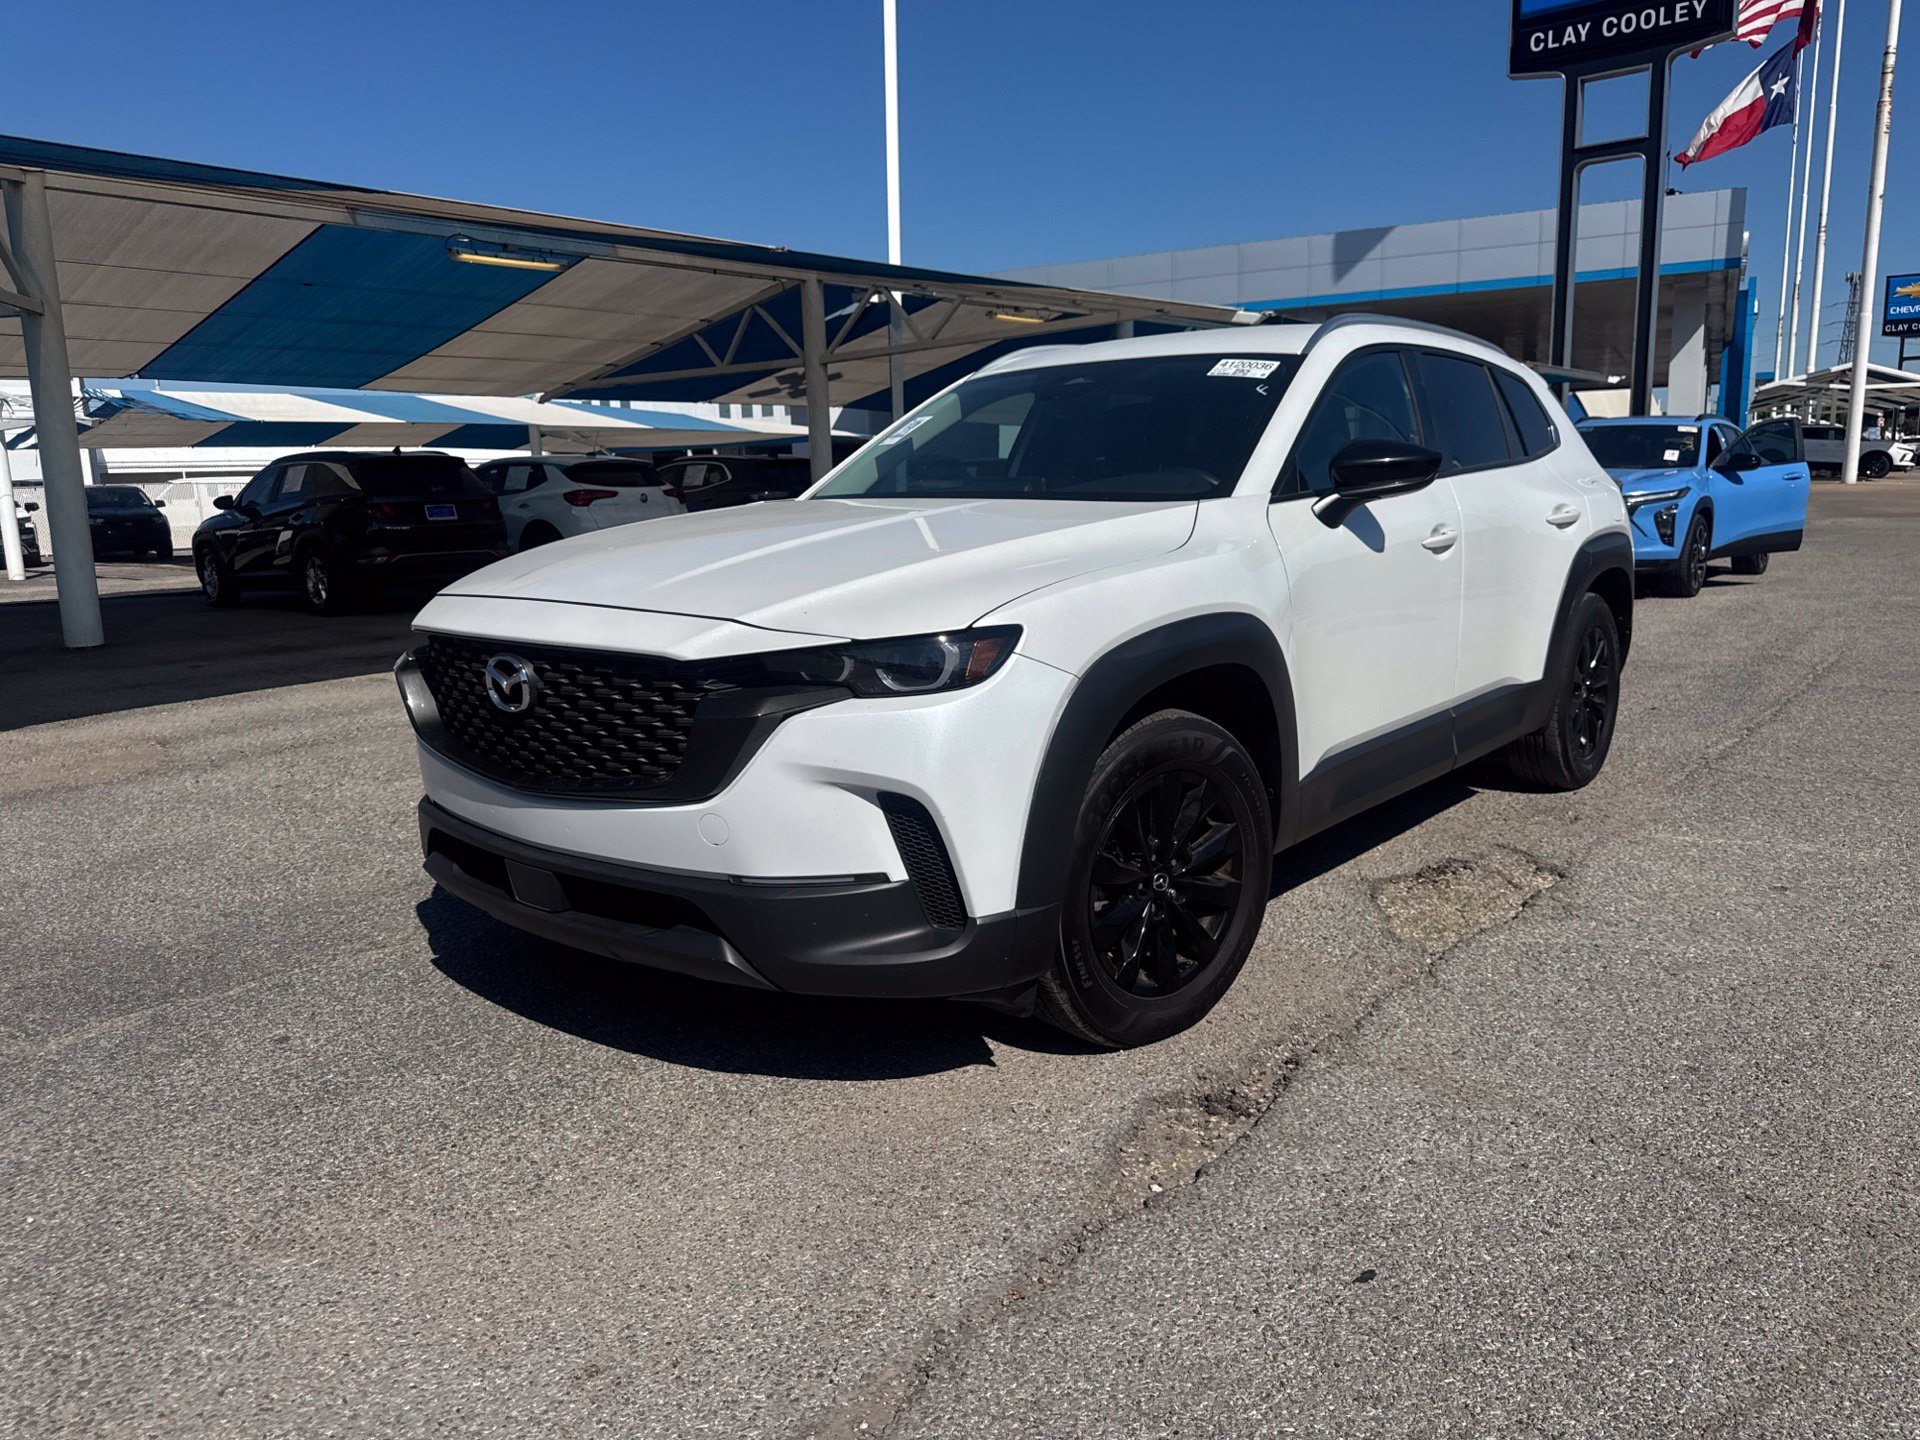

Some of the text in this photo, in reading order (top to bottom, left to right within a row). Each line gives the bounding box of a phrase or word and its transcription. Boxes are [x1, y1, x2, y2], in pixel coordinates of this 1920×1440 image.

[1530, 0, 1706, 52] CLAY COOLEY
[1885, 324, 1909, 332] CLAY
[1219, 361, 1275, 370] 4120036
